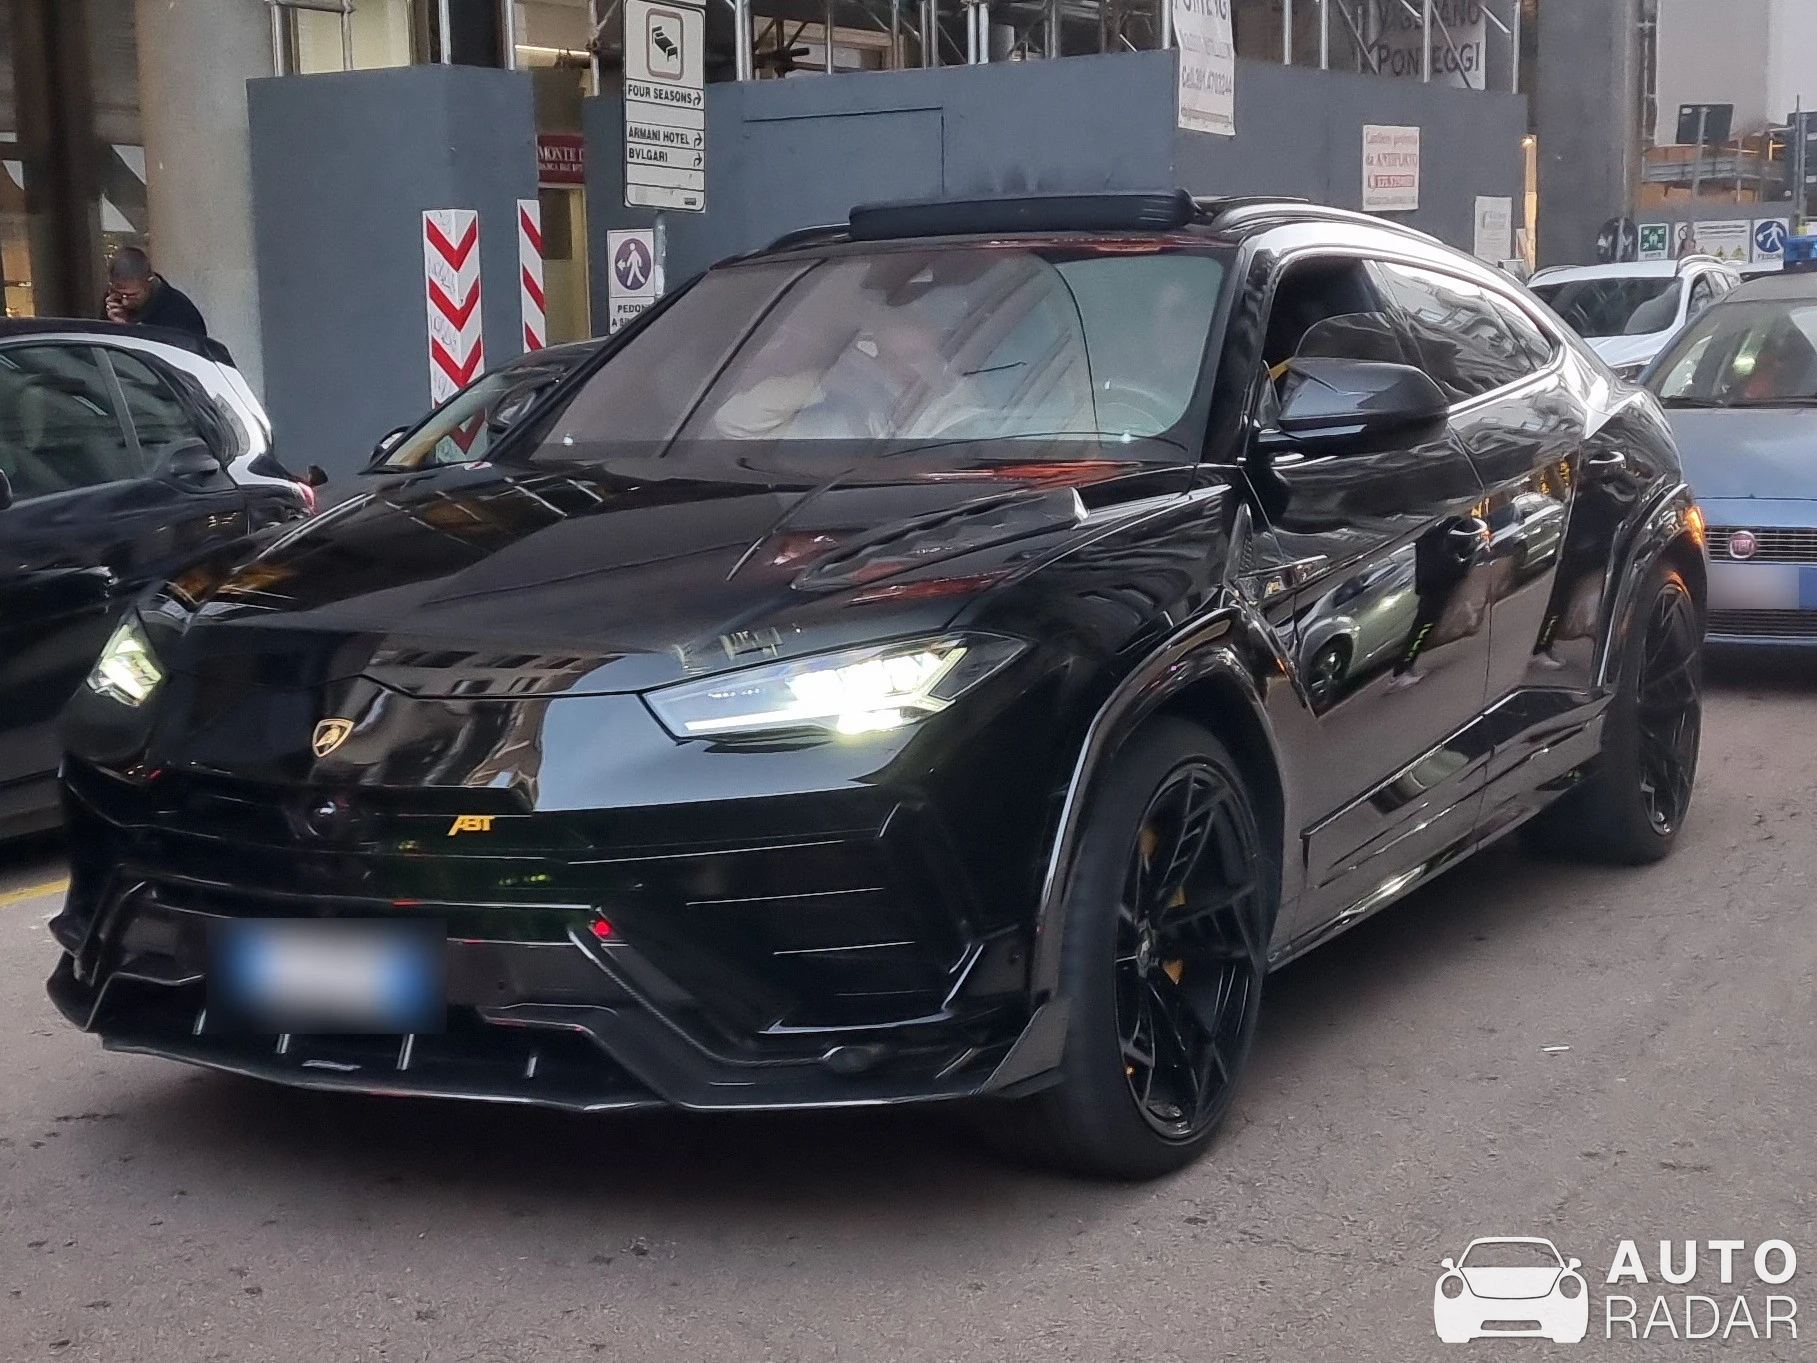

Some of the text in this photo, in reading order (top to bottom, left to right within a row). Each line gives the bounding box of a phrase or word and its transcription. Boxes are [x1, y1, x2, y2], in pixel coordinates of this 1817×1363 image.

[1379, 41, 1481, 76] PONEGGI
[628, 84, 692, 104] FOUR SEASONS
[628, 125, 690, 145] ARMANI HOTEL
[628, 147, 668, 162] BVLGARI
[447, 815, 496, 836] ABT
